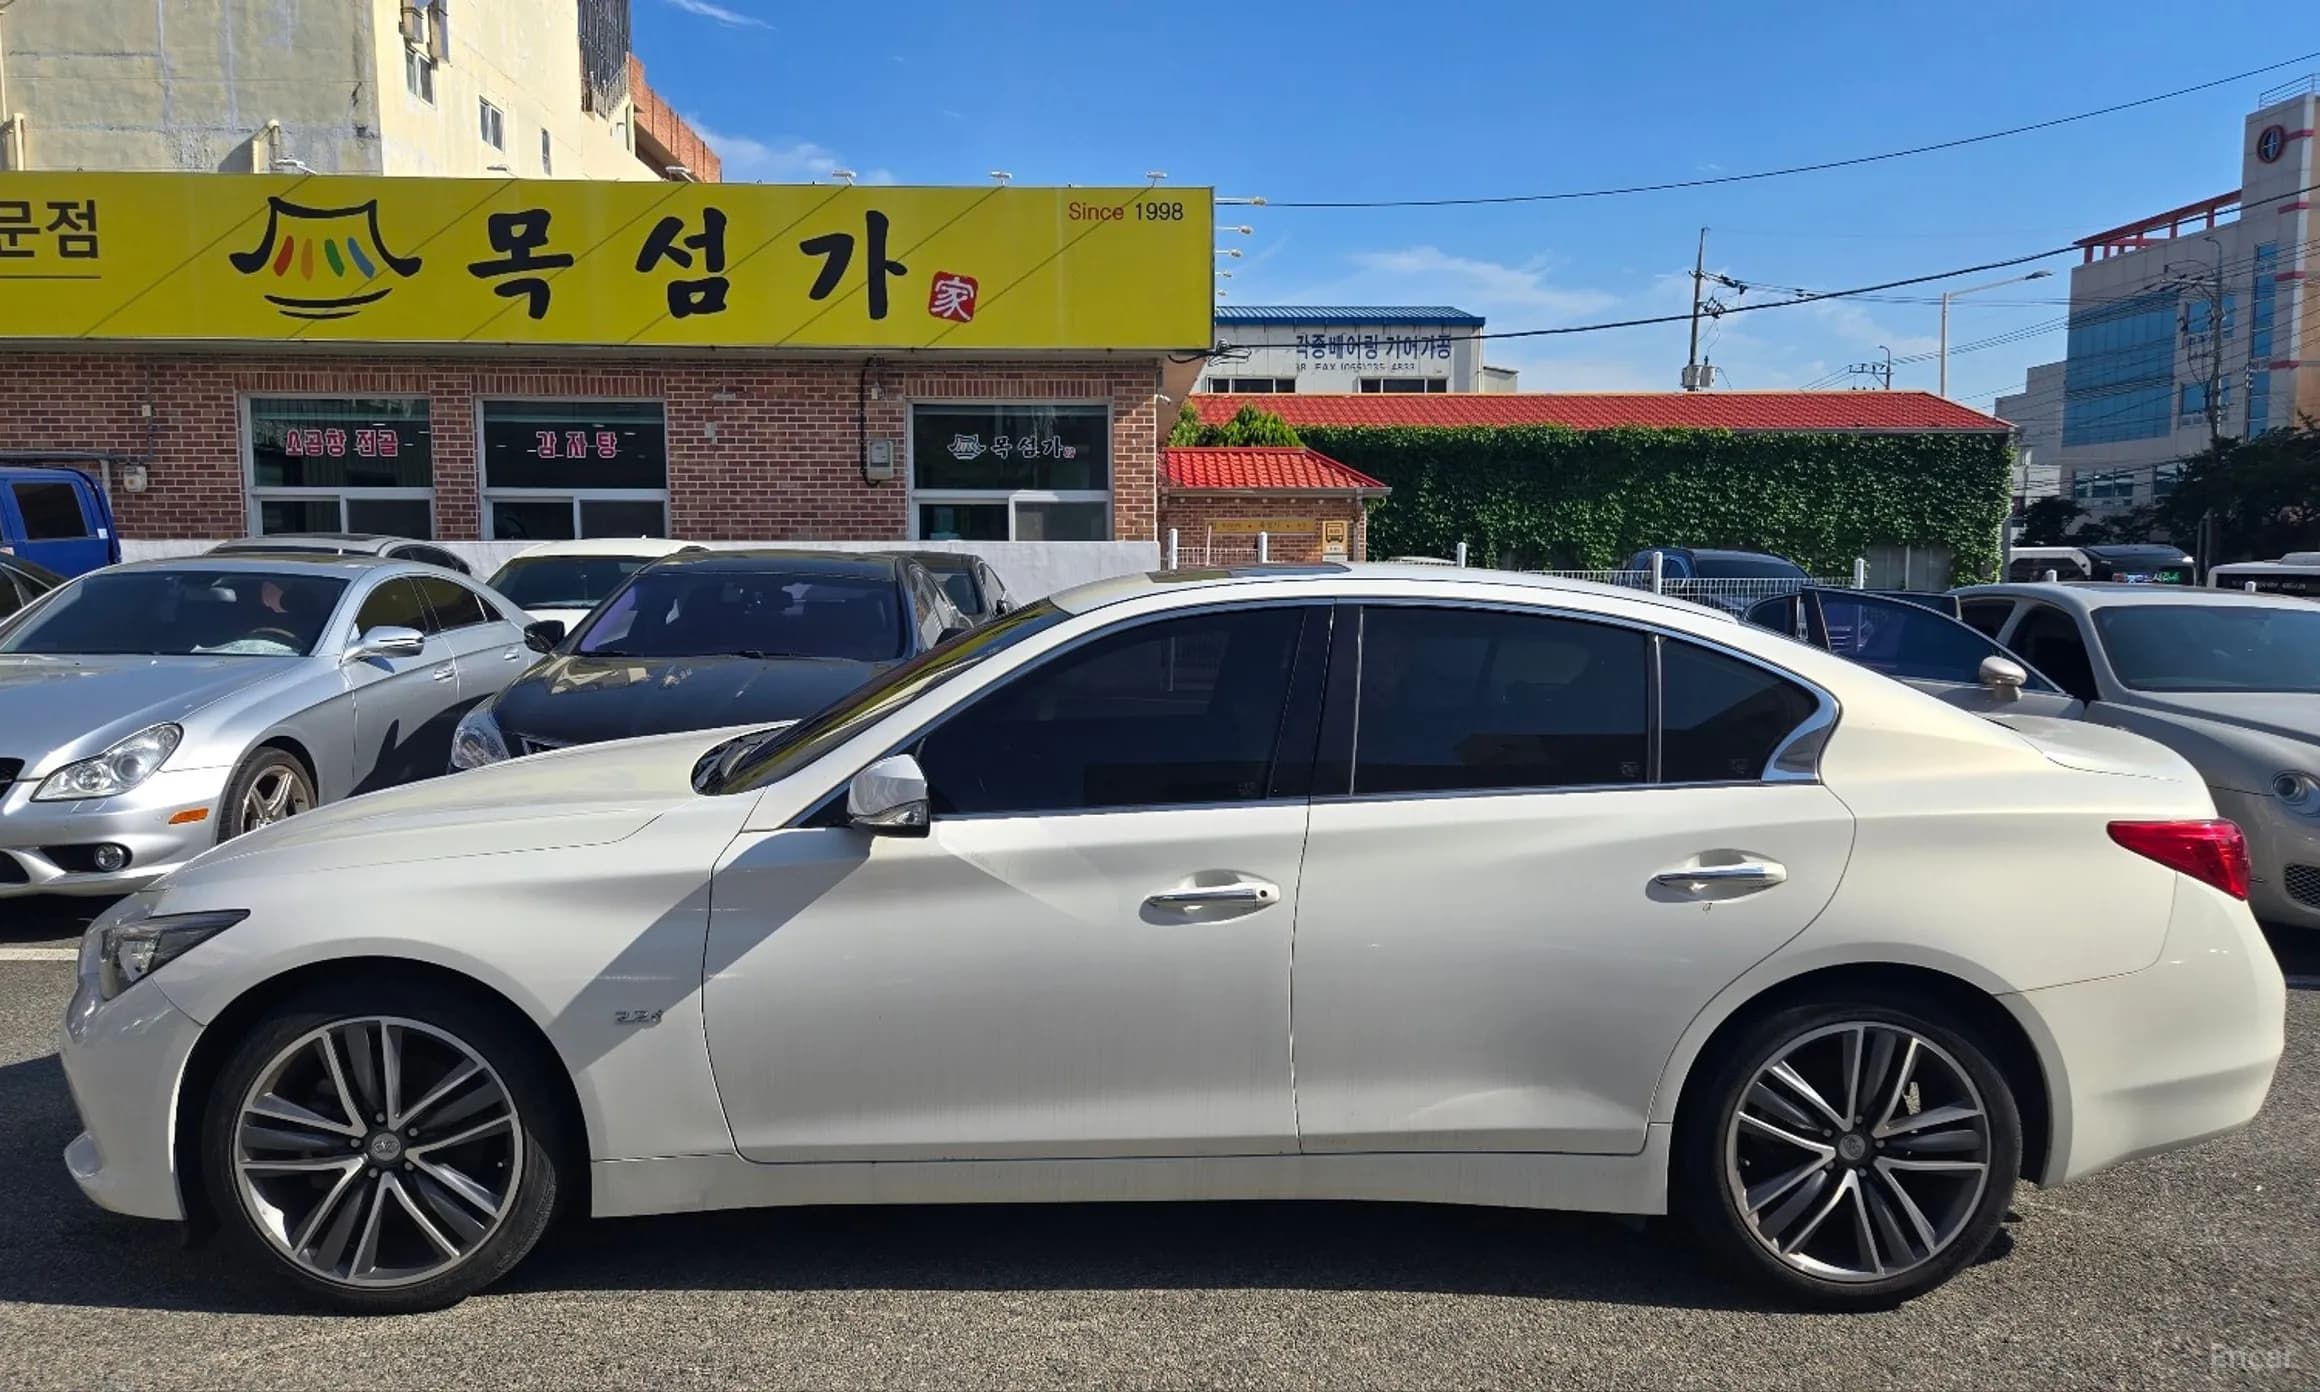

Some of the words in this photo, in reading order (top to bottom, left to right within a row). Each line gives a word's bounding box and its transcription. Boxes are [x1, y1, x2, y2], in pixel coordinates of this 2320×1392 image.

[1068, 202, 1124, 221] Since
[1135, 202, 1184, 221] 1998
[930, 275, 976, 321] 家
[355, 429, 398, 457] 전골
